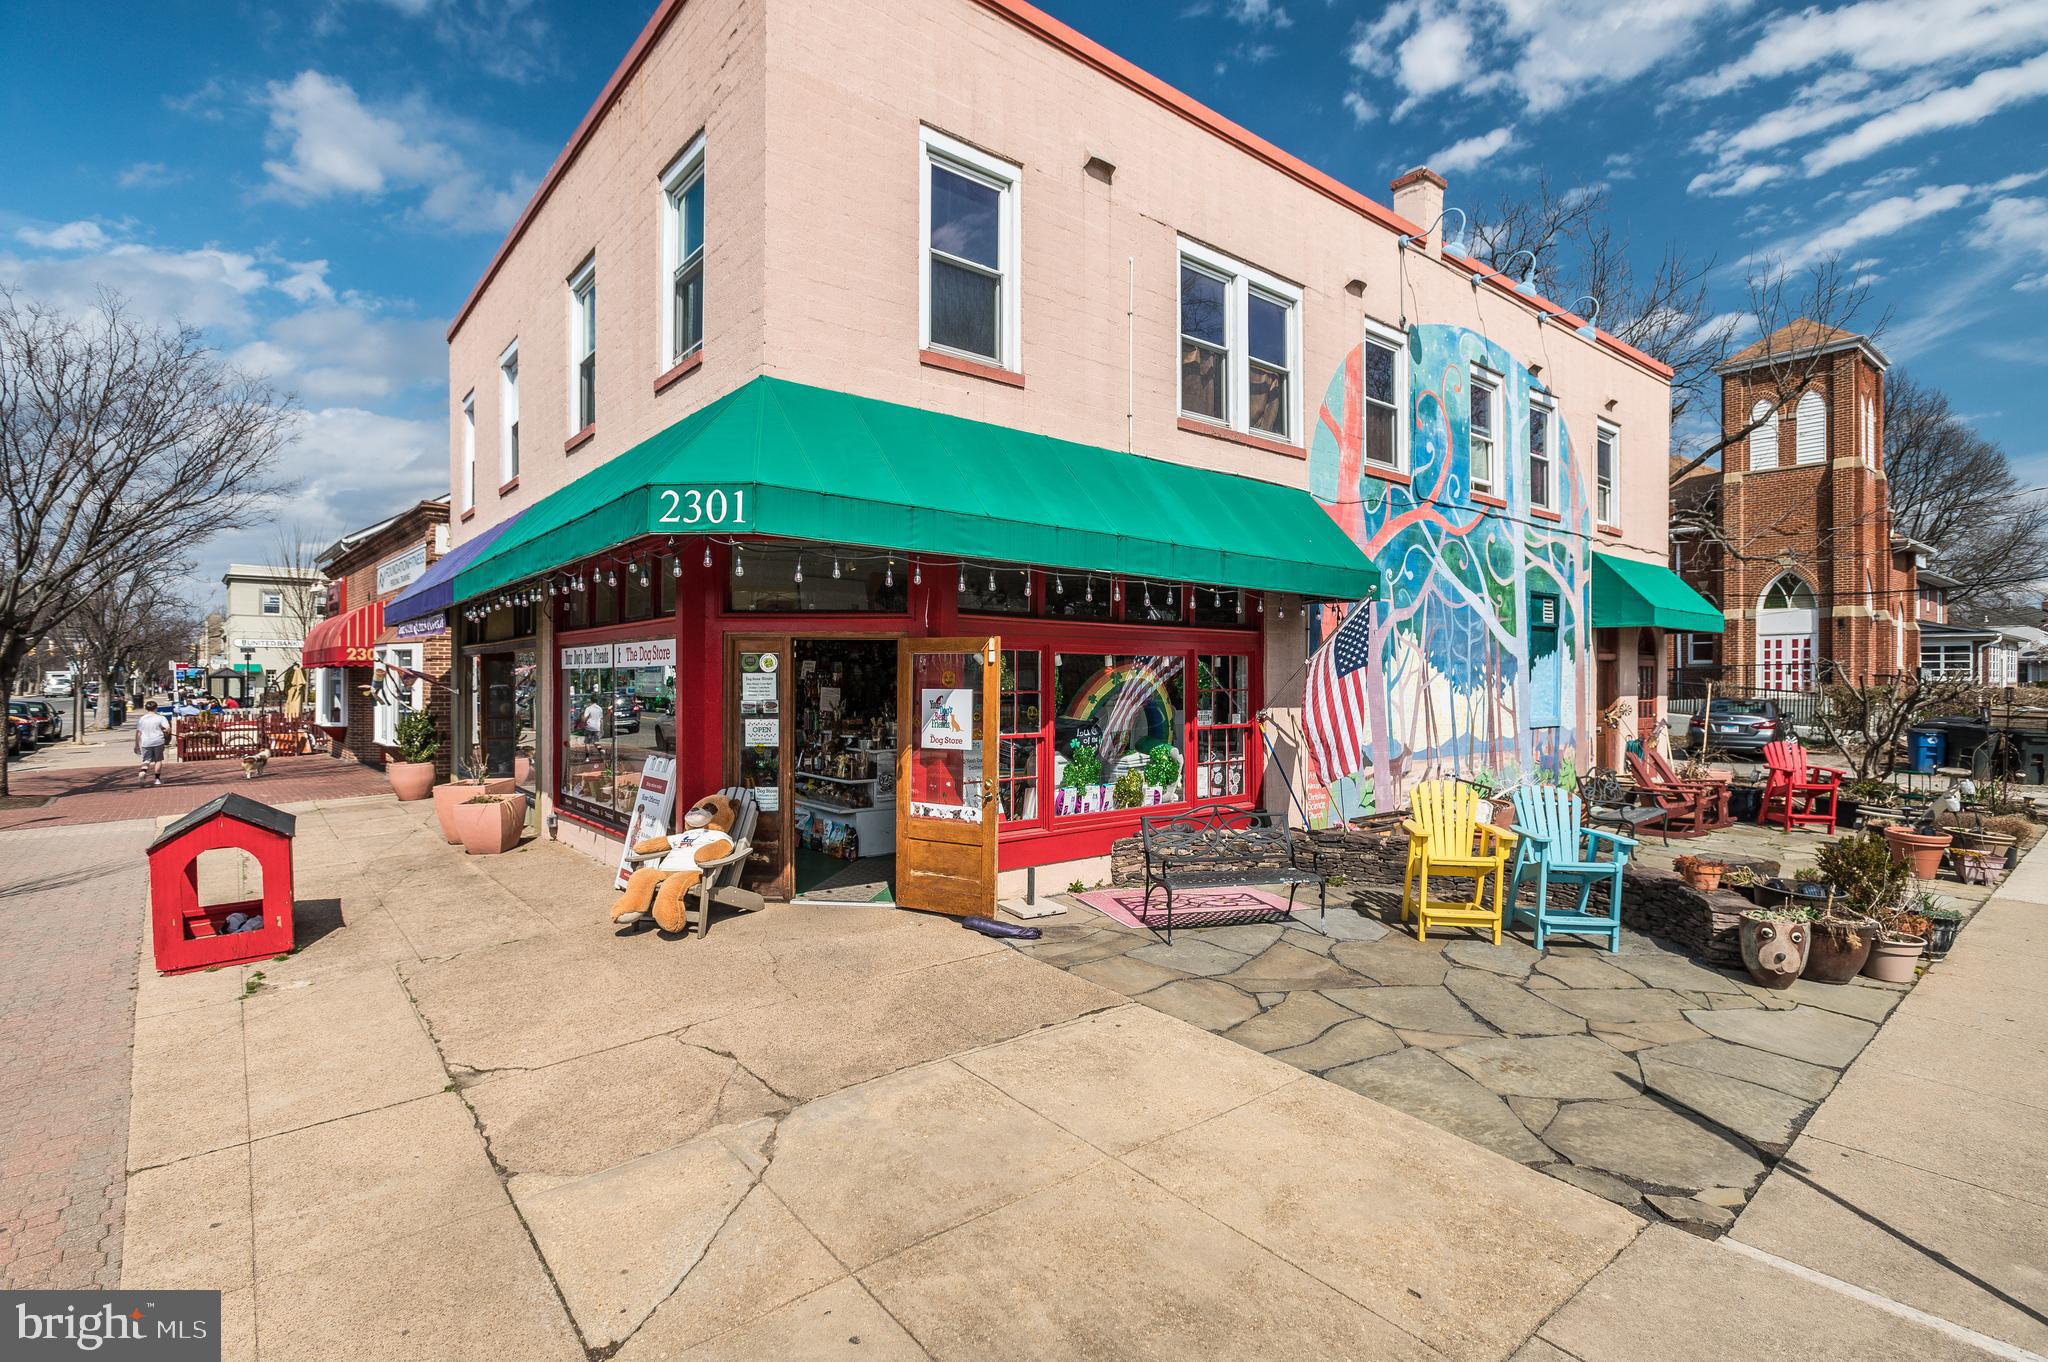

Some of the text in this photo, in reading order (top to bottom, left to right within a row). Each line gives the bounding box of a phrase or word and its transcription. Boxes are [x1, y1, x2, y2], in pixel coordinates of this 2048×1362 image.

[659, 489, 746, 523] 2301
[584, 648, 592, 665] Best
[593, 647, 609, 664] Friends
[626, 645, 671, 664] The Dog Store
[934, 711, 946, 721] Best
[931, 719, 951, 729] Friends
[930, 735, 944, 746] Dog
[944, 736, 963, 745] Store
[1308, 802, 1325, 810] Science
